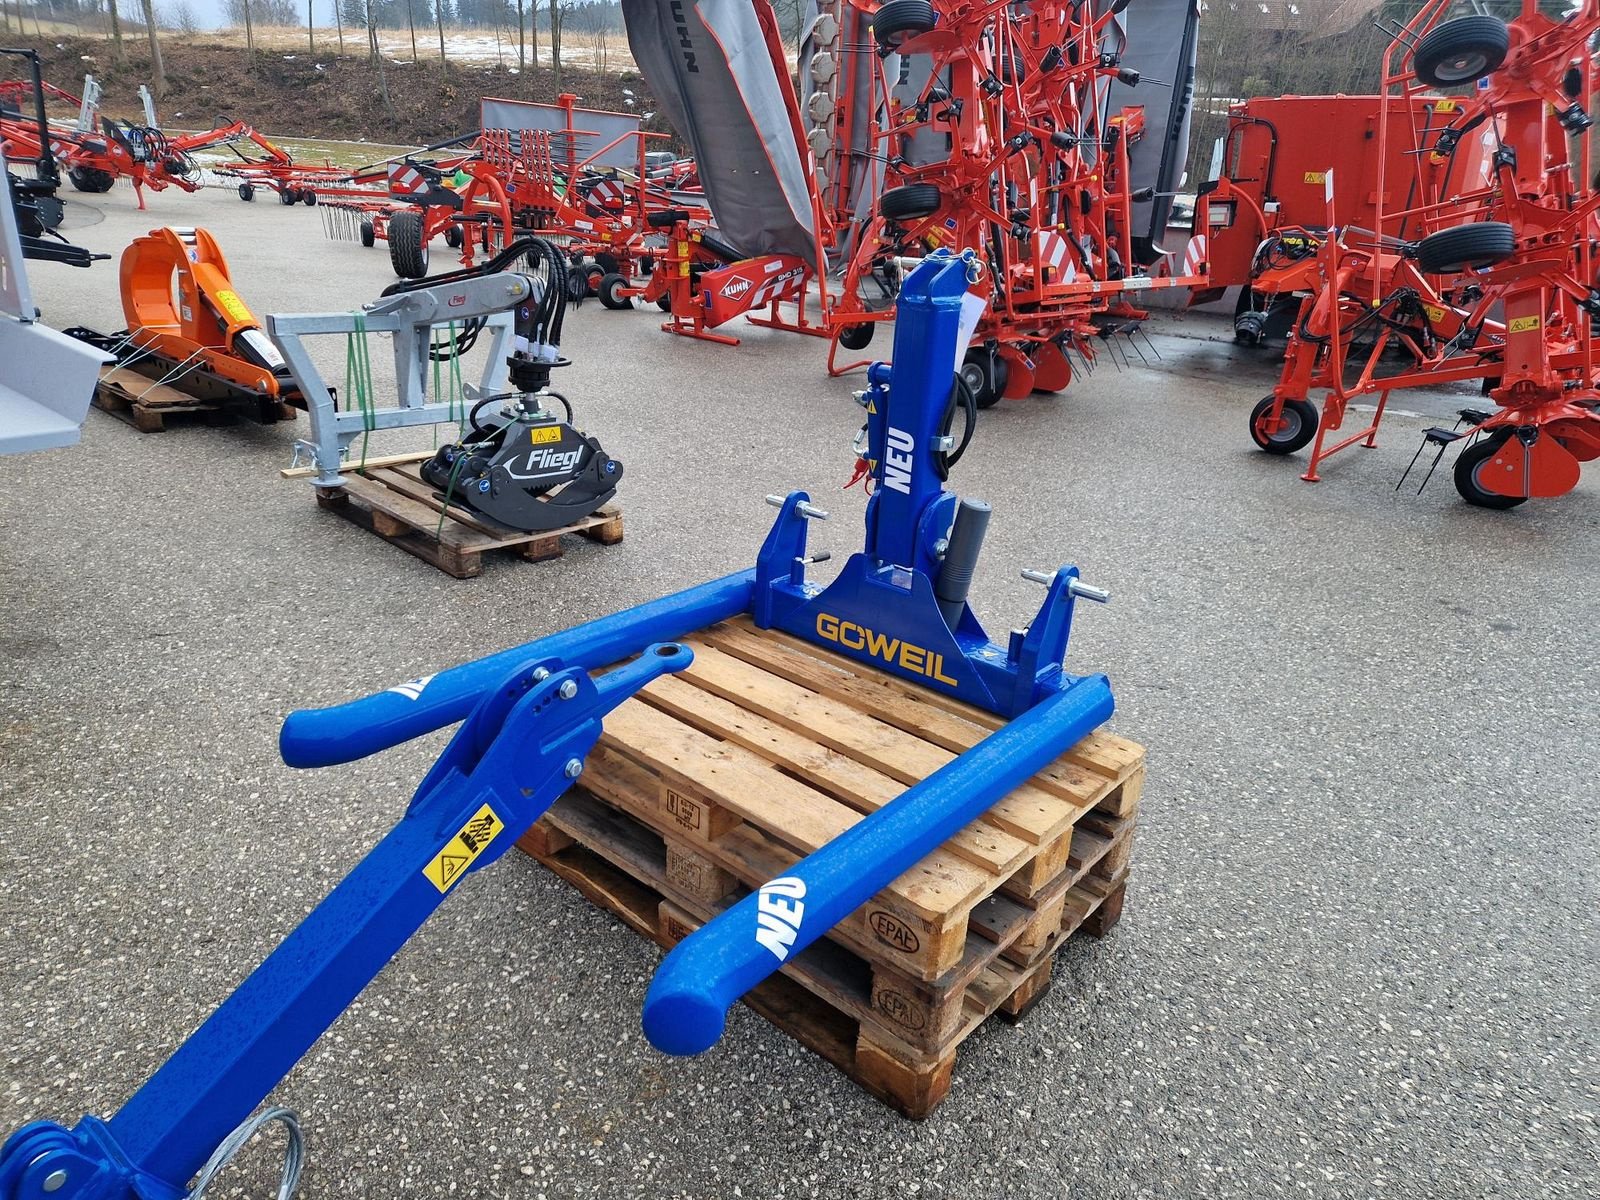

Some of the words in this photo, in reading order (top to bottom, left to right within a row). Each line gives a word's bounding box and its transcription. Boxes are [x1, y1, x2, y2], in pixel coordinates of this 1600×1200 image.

[670, 0, 699, 73] UHN
[898, 54, 911, 85] HN
[724, 281, 749, 296] KUHN
[526, 444, 584, 471] Fliegl
[884, 426, 915, 495] NEU
[755, 876, 807, 962] NEU
